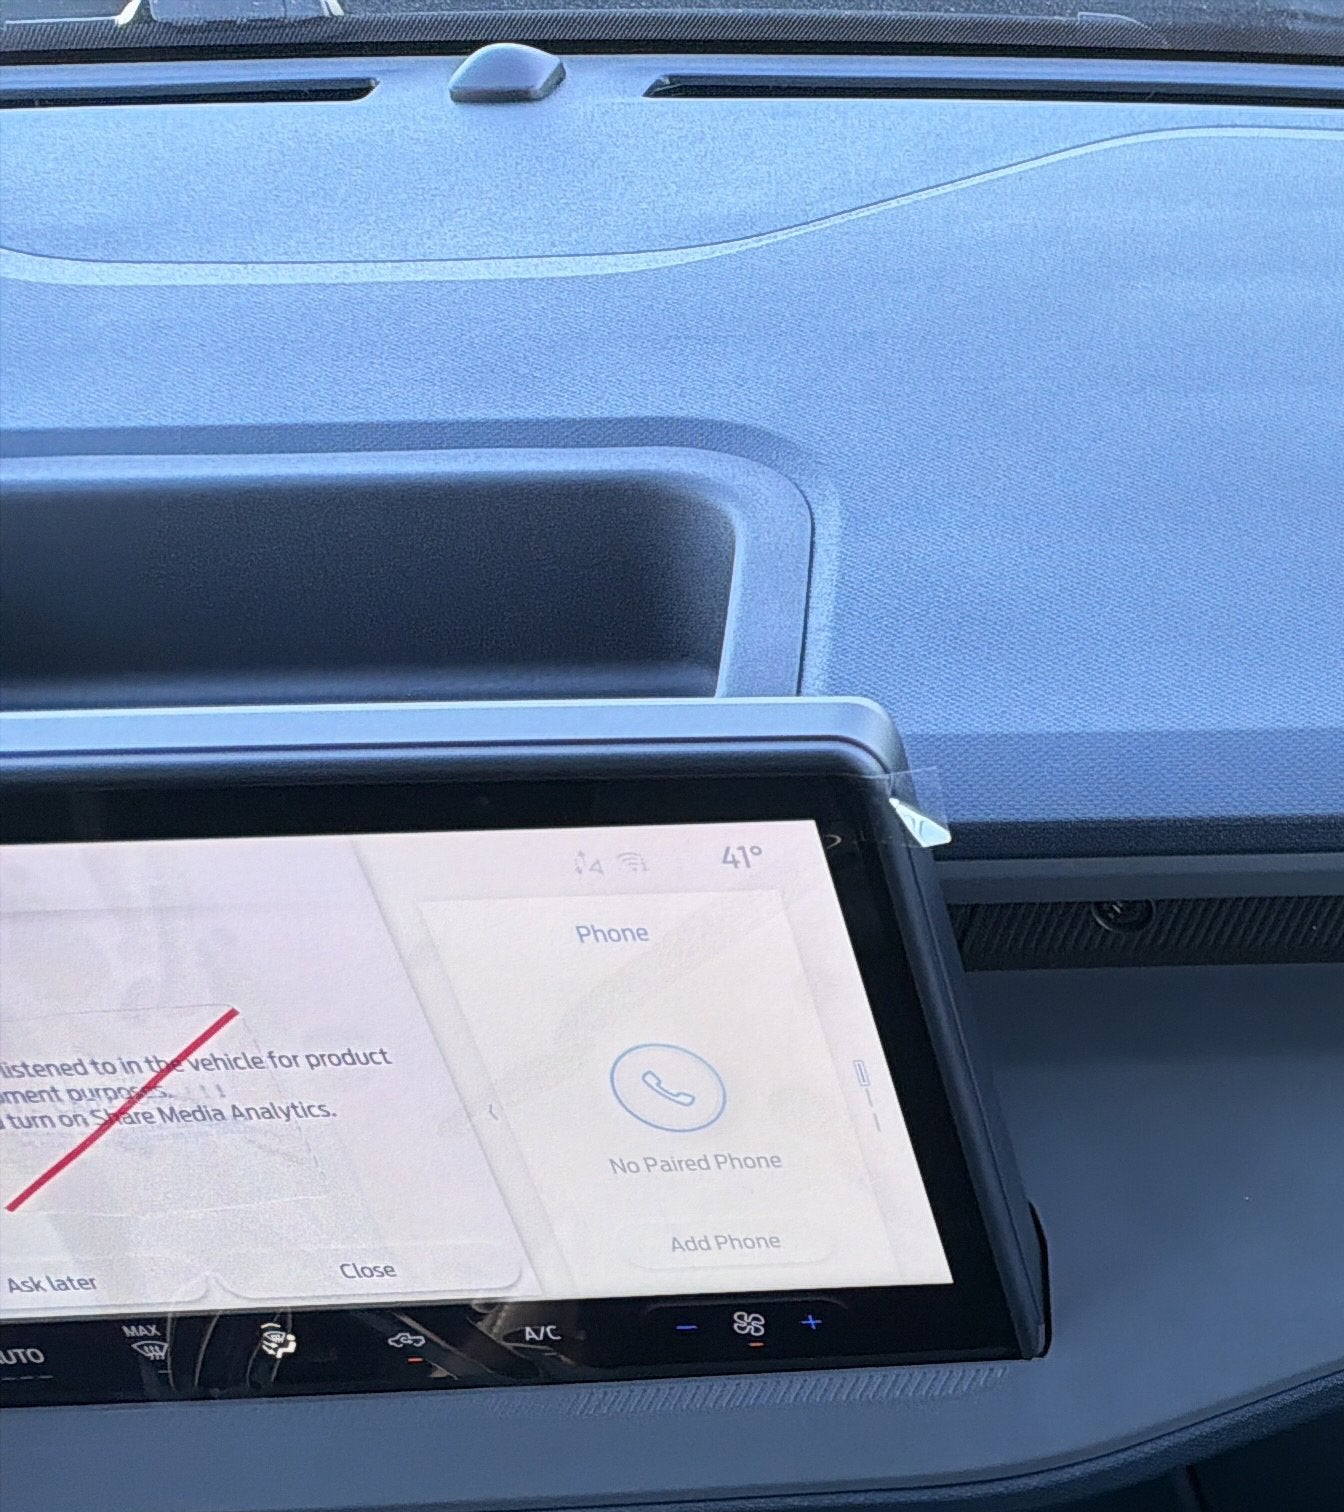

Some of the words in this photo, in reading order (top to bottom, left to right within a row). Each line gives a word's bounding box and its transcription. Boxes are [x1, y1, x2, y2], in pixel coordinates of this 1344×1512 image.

[575, 924, 650, 943] Phone
[0, 1058, 90, 1079] listened
[90, 1058, 117, 1076] to
[118, 1056, 143, 1074] in
[186, 1051, 264, 1072] vehicle
[266, 1050, 300, 1069] for
[304, 1047, 393, 1071] product
[0, 1085, 64, 1105] ment
[6, 1112, 56, 1130] turn
[58, 1113, 90, 1128] on
[156, 1104, 226, 1124] Media
[230, 1101, 337, 1122] Analytics.
[608, 1157, 641, 1175] No
[643, 1154, 712, 1173] Paired
[713, 1153, 783, 1170] Phone
[671, 1235, 712, 1252] Add
[713, 1234, 782, 1251] Phone
[338, 1262, 398, 1279] Close
[7, 1276, 47, 1294] Ask
[45, 1275, 97, 1292] later
[121, 1324, 162, 1338] MAX
[524, 1325, 562, 1342] A/C
[0, 1348, 45, 1365] UTO
